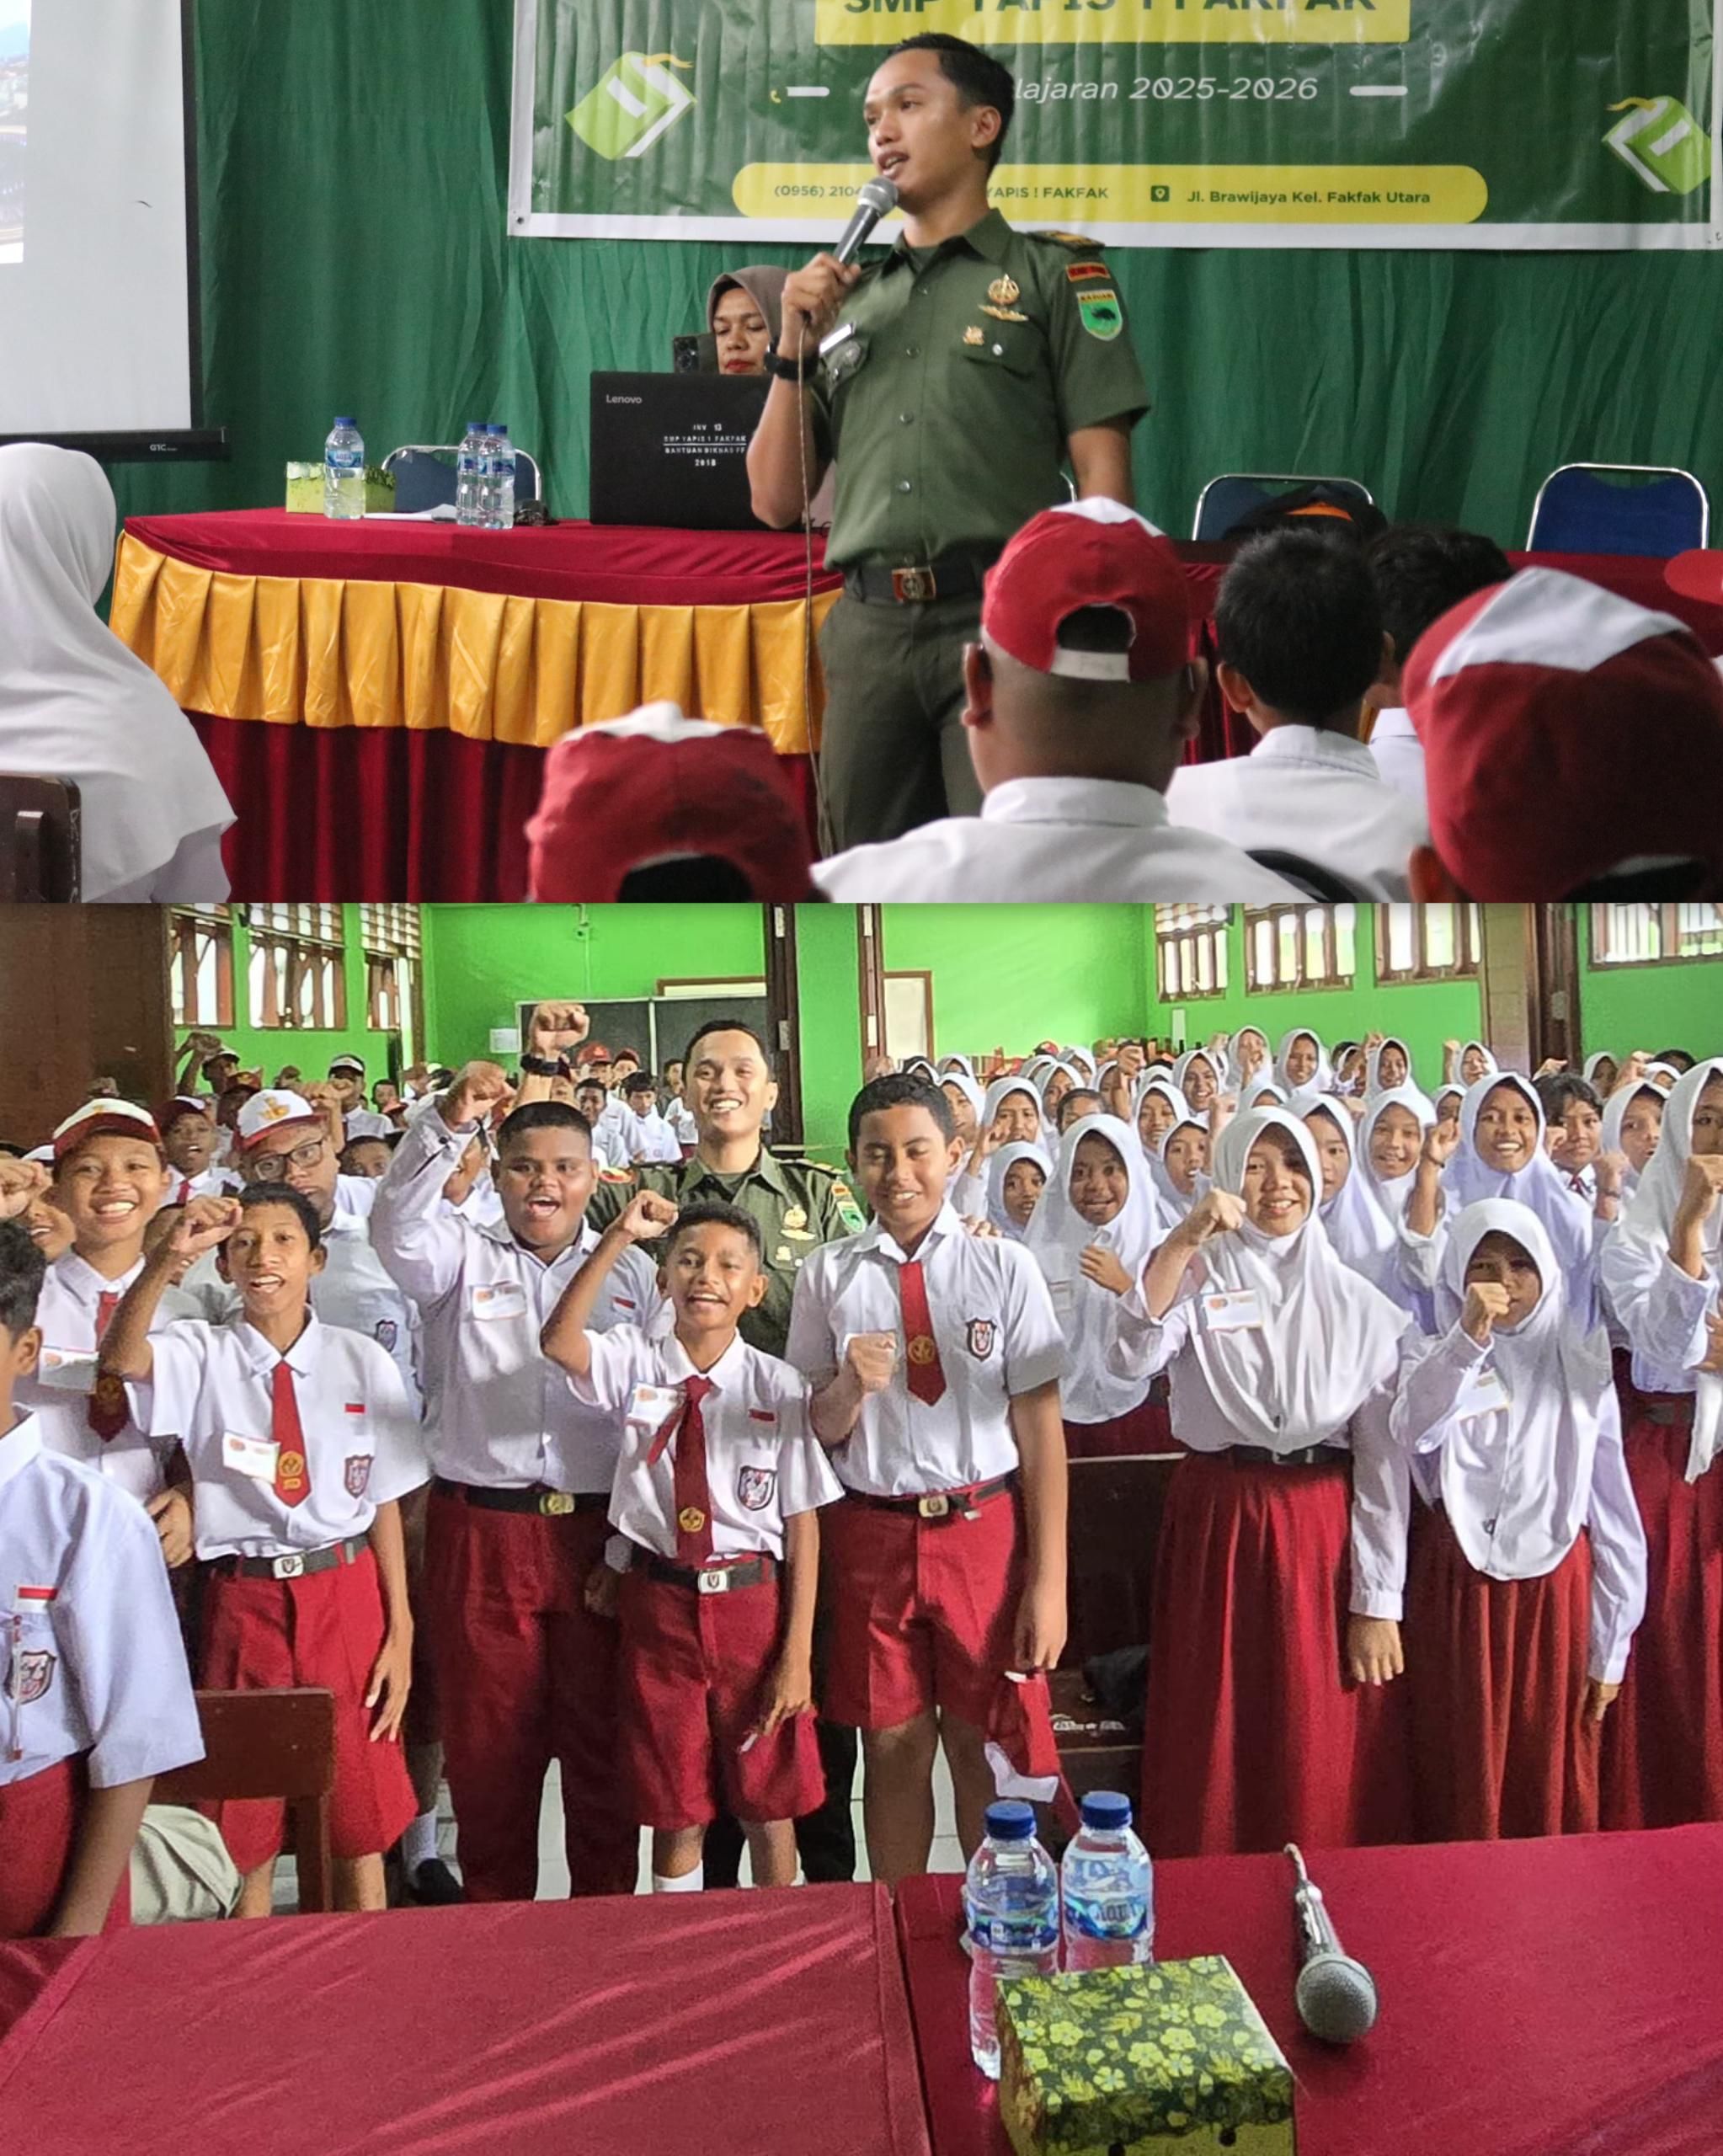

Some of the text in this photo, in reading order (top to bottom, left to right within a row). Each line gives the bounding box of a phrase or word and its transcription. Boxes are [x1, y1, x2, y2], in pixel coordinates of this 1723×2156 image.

[1015, 77, 1319, 104] lajaran 2025-2026
[774, 185, 824, 198] (0956)
[1043, 187, 1109, 199] FAKFAK
[1187, 190, 1431, 205] Jl. Brawijaya Kel. Fakfak Utara
[605, 393, 643, 404] Lenovo
